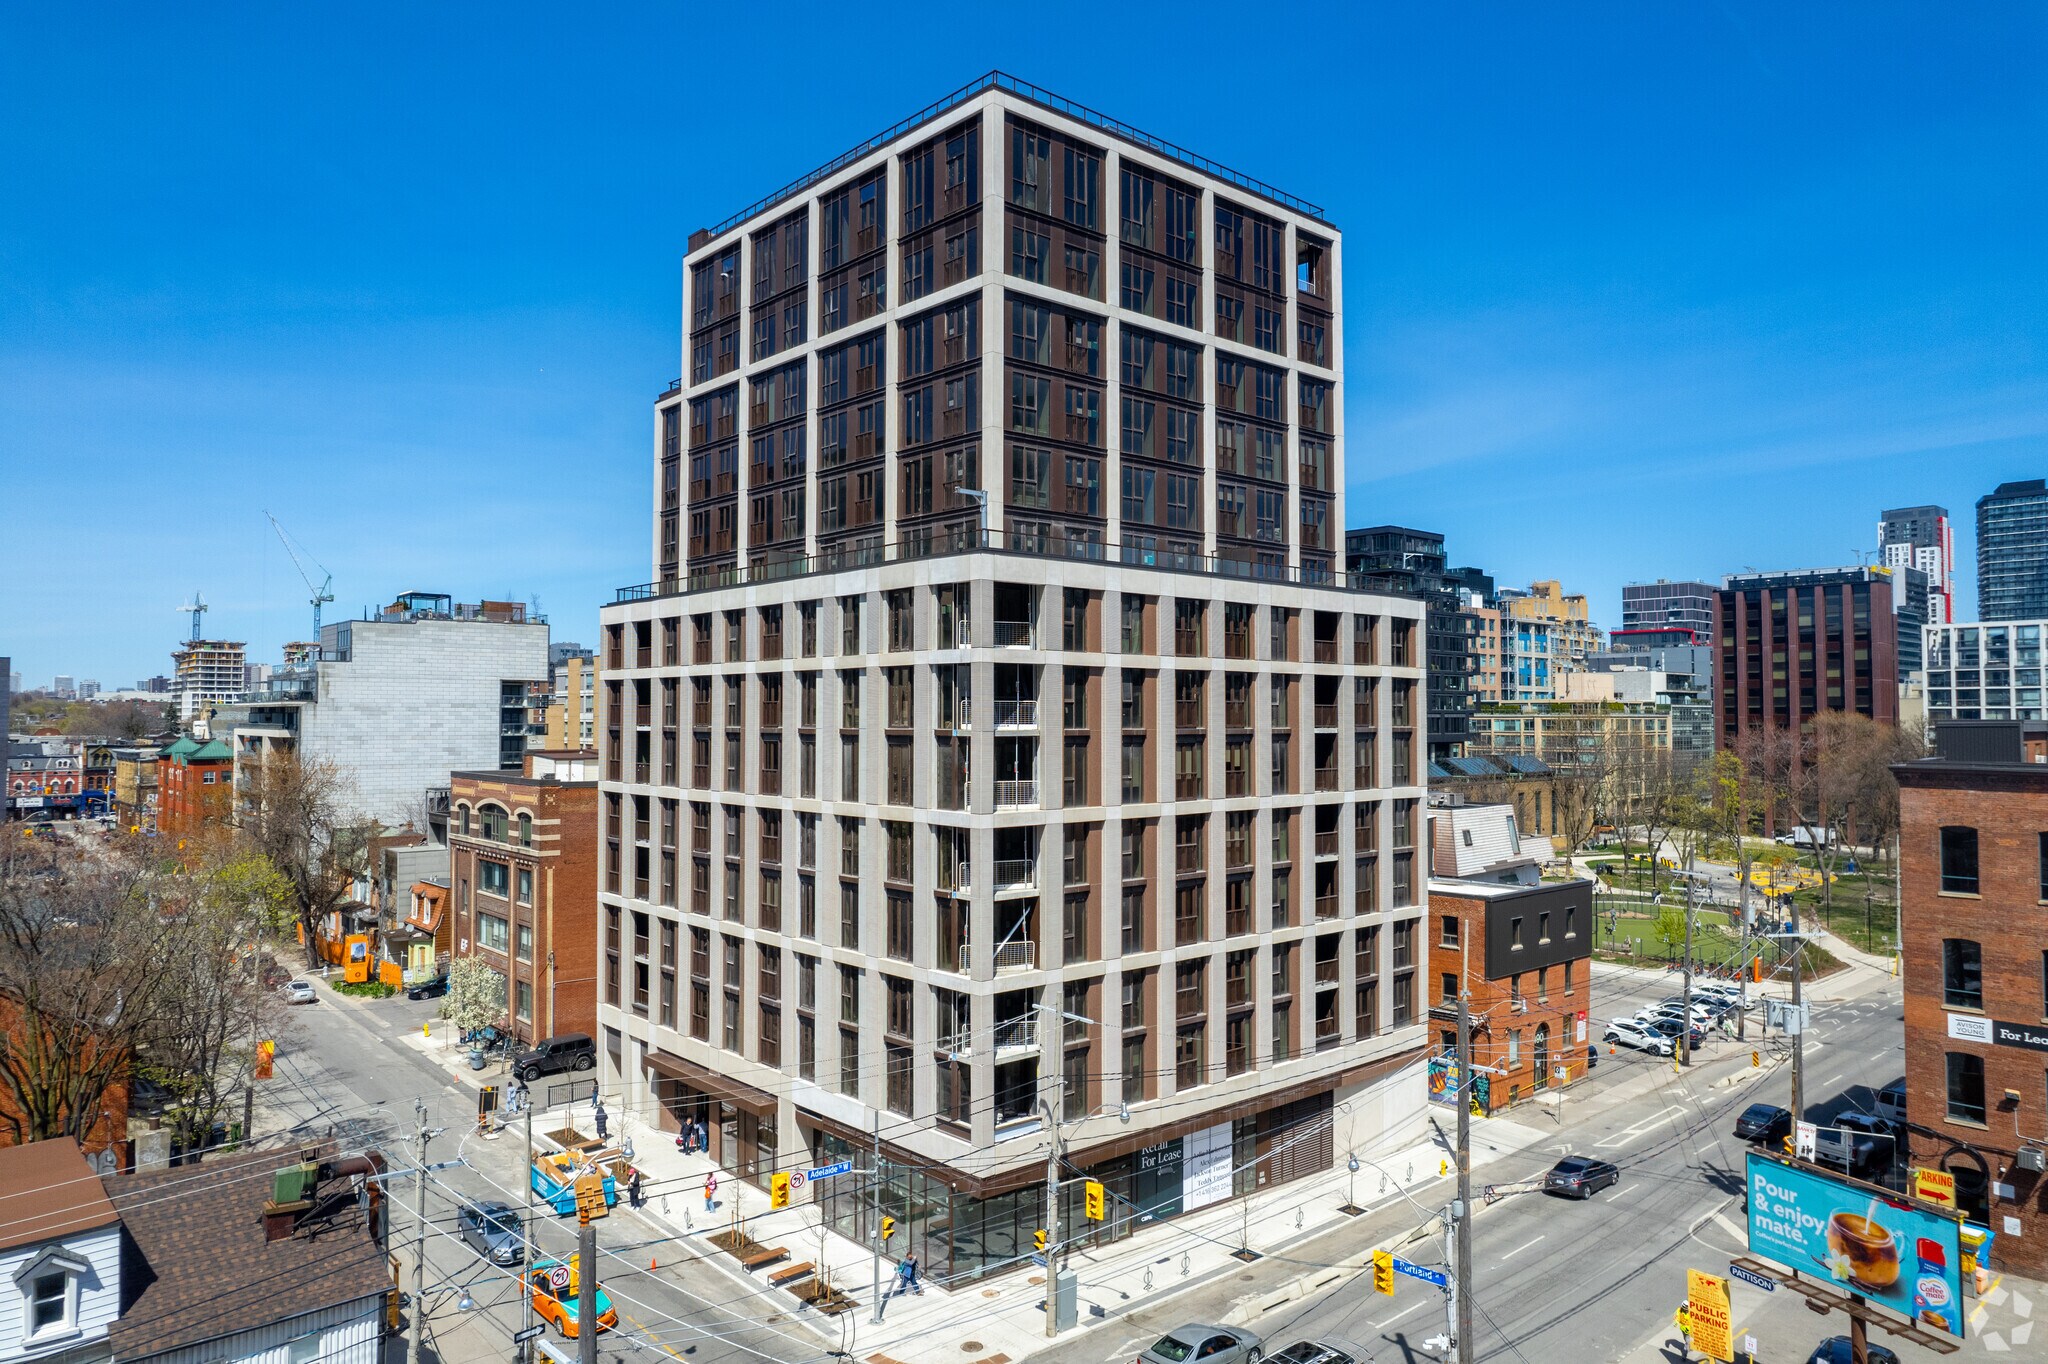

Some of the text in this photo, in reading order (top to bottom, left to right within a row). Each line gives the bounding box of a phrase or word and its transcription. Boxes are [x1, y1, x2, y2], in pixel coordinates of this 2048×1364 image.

[1957, 1022, 1985, 1030] AVISON
[1957, 1027, 1985, 1036] YOUNG
[2000, 1029, 2021, 1040] For
[1142, 1157, 1156, 1169] For
[1158, 1149, 1182, 1164] Lease
[810, 1166, 838, 1179] Adelaide
[843, 1162, 849, 1171] W
[1754, 1173, 1798, 1204] Pour
[1754, 1192, 1770, 1213] &
[1755, 1214, 1808, 1245] mate.
[1400, 1261, 1432, 1280] Portland
[1731, 1267, 1773, 1291] PATTISON
[1920, 1283, 1943, 1294] Coffee
[1925, 1291, 1945, 1300] mate
[1690, 1300, 1727, 1320] PUBLIC
[1690, 1311, 1728, 1330] PARKING
